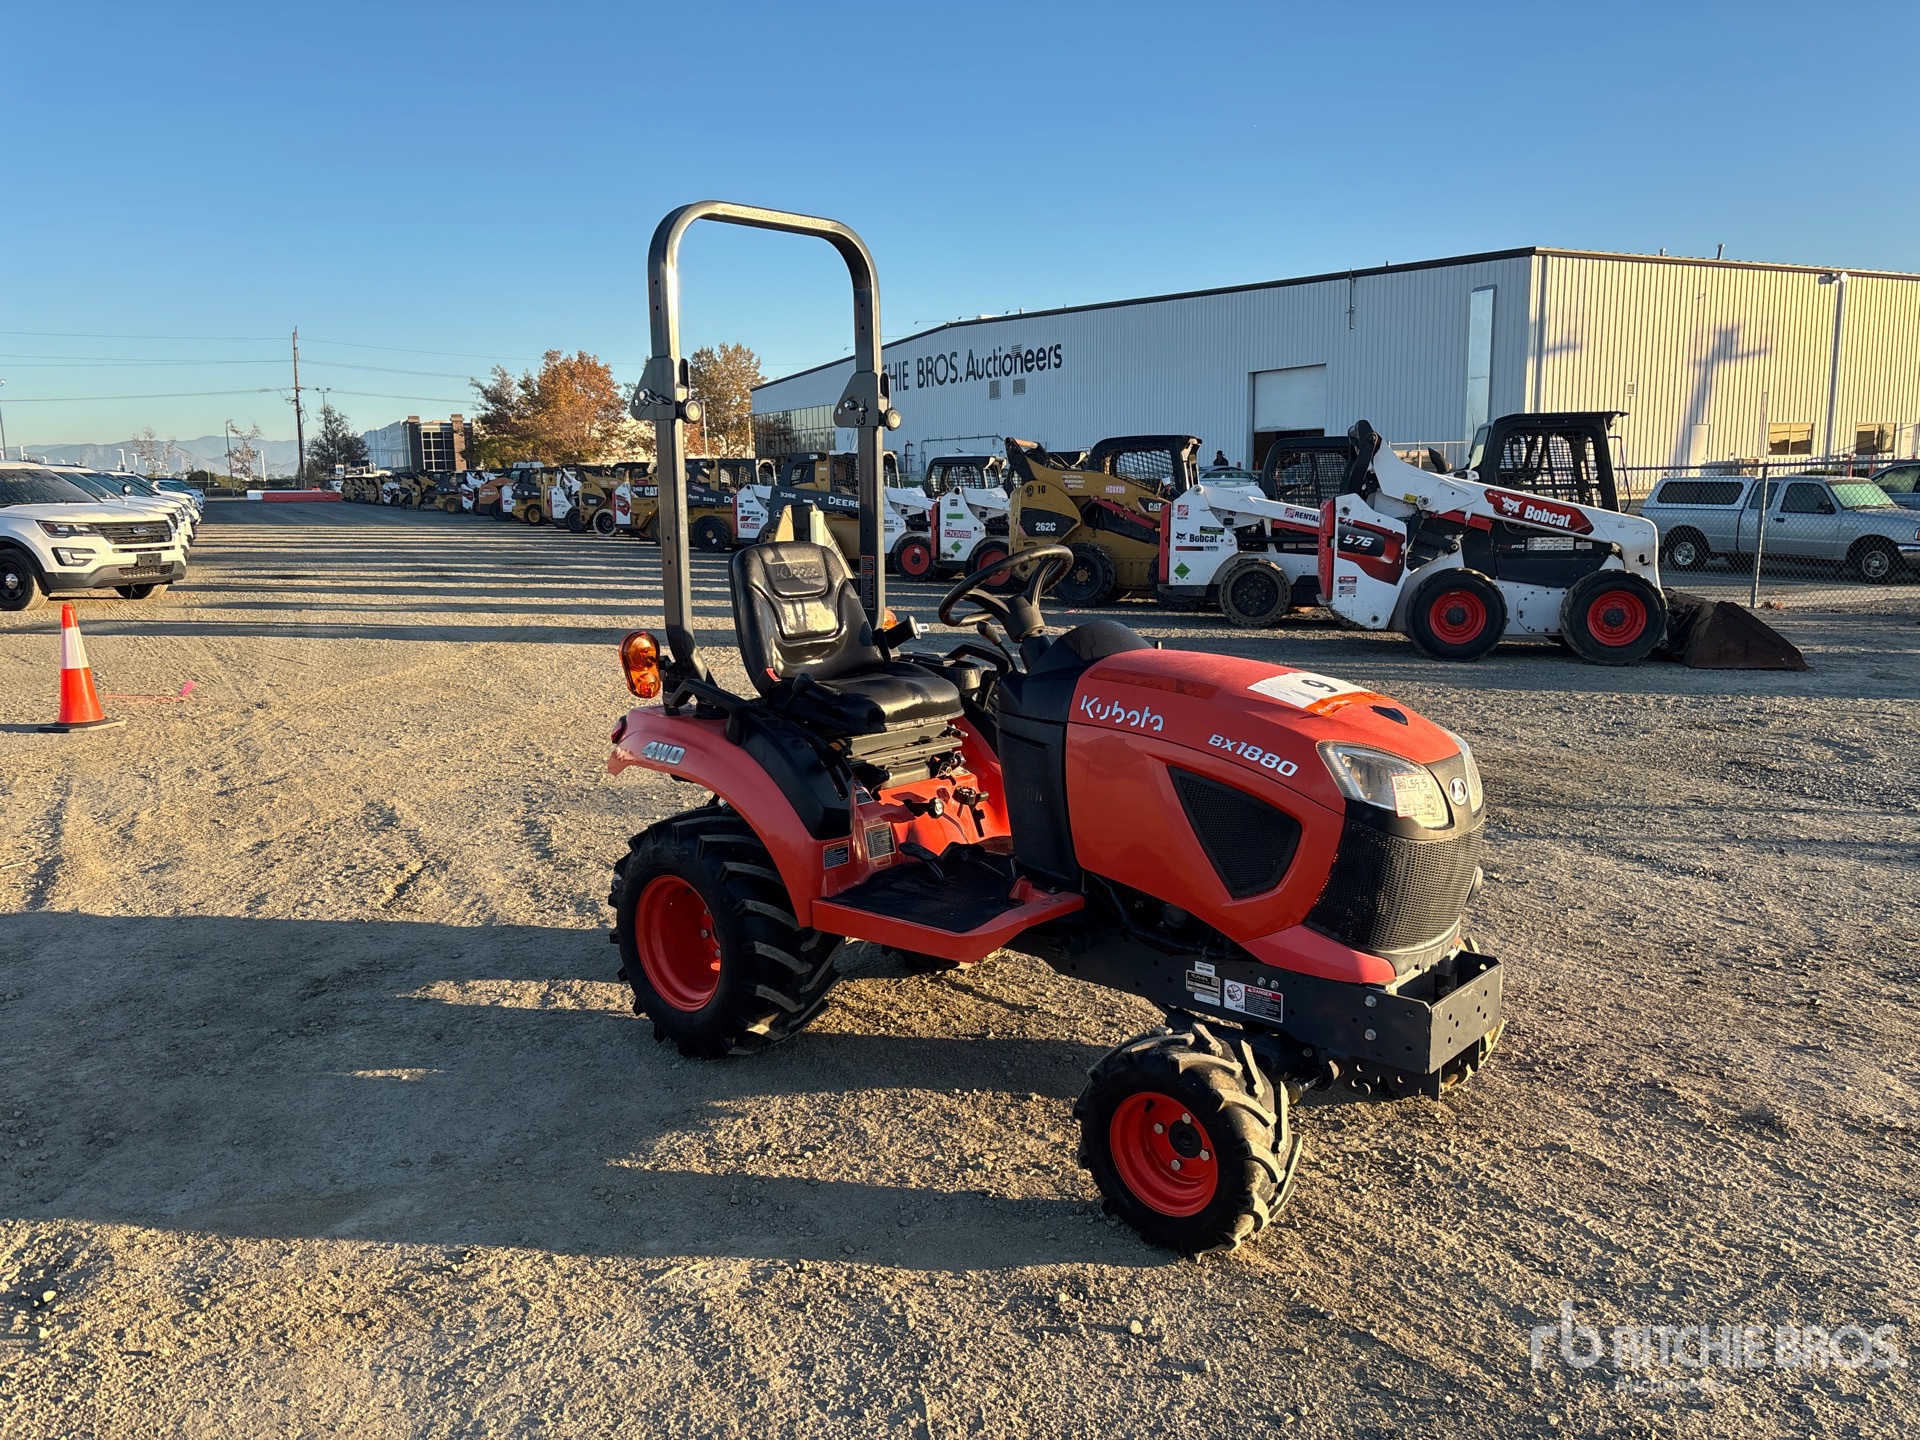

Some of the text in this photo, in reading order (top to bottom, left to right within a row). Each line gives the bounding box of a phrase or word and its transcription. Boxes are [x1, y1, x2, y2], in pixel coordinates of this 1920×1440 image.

[917, 352, 963, 389] BROS.
[965, 343, 1063, 382] Auctioneers
[644, 486, 659, 496] CAT
[828, 496, 860, 508] DEERE
[1148, 502, 1163, 512] CAT
[1295, 511, 1320, 523] RENTAL
[1523, 504, 1571, 528] Bobcat
[1035, 522, 1056, 532] 262C
[1189, 533, 1218, 543] Bobcat
[1343, 534, 1375, 547] S76
[1080, 694, 1165, 732] Kubota
[641, 740, 686, 765] 4WD
[1207, 733, 1299, 777] BX1880
[1251, 988, 1273, 998] DANGER
